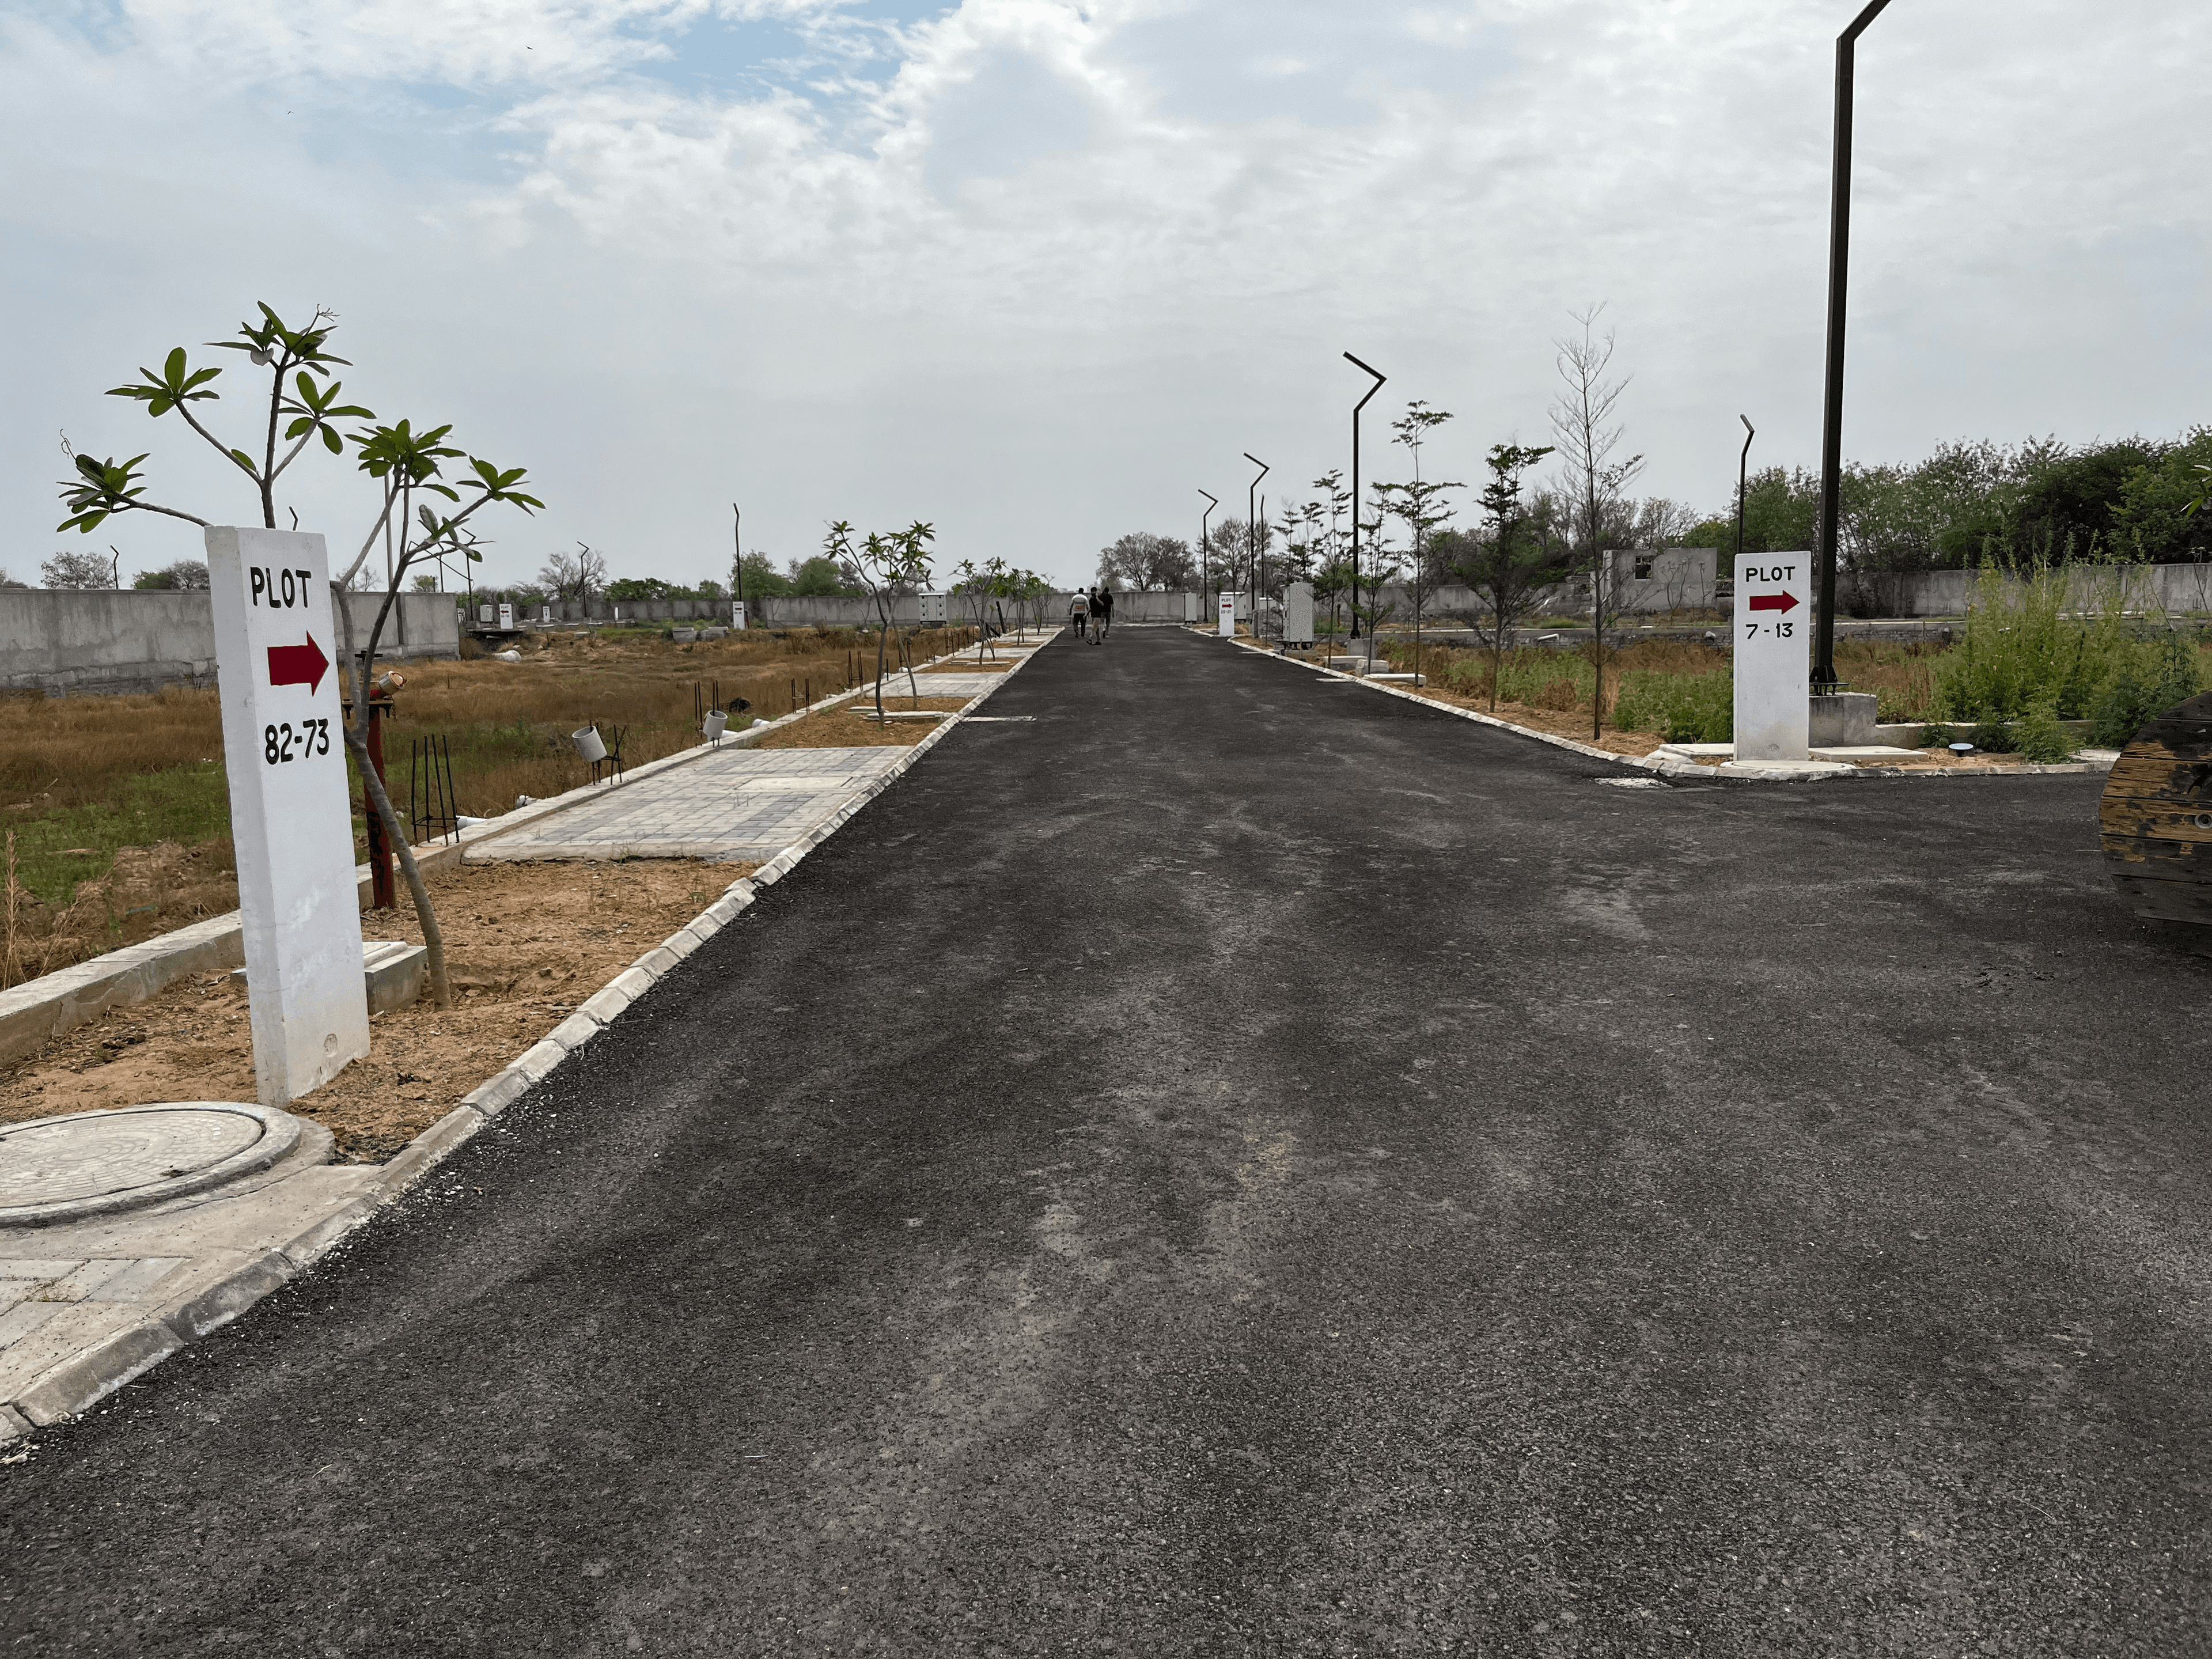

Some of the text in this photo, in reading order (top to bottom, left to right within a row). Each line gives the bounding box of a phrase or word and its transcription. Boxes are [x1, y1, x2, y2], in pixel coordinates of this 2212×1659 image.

[250, 566, 312, 608] PLOT
[1745, 566, 1796, 582] PLOT
[265, 718, 329, 765] 82-73
